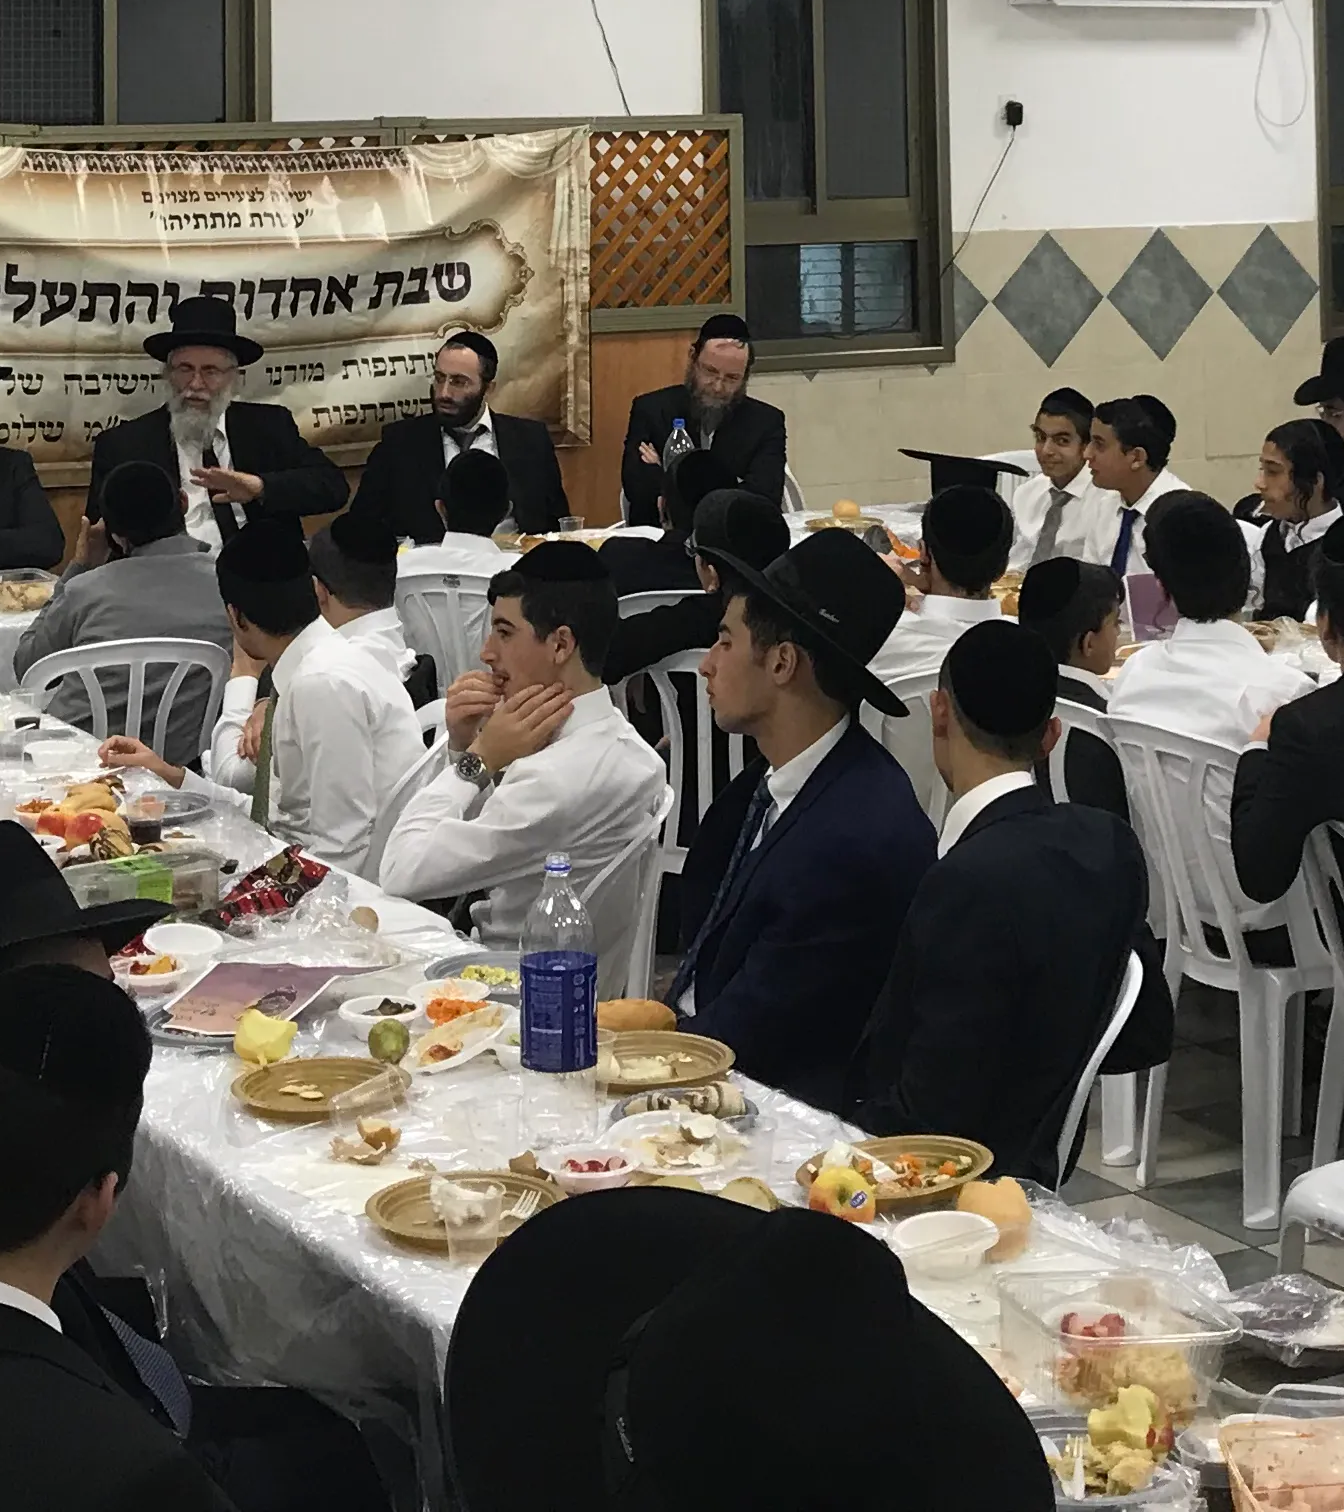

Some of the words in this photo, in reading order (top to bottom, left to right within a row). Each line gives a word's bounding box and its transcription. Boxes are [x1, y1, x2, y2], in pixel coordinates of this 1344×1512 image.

[141, 189, 201, 204] מצוינם
[204, 186, 265, 203] לצעירים
[270, 189, 313, 203] ישיה
[367, 261, 472, 310] שבת
[63, 372, 164, 396] הישיבה
[265, 361, 325, 386] מורנו
[311, 397, 434, 428] השתתפות
